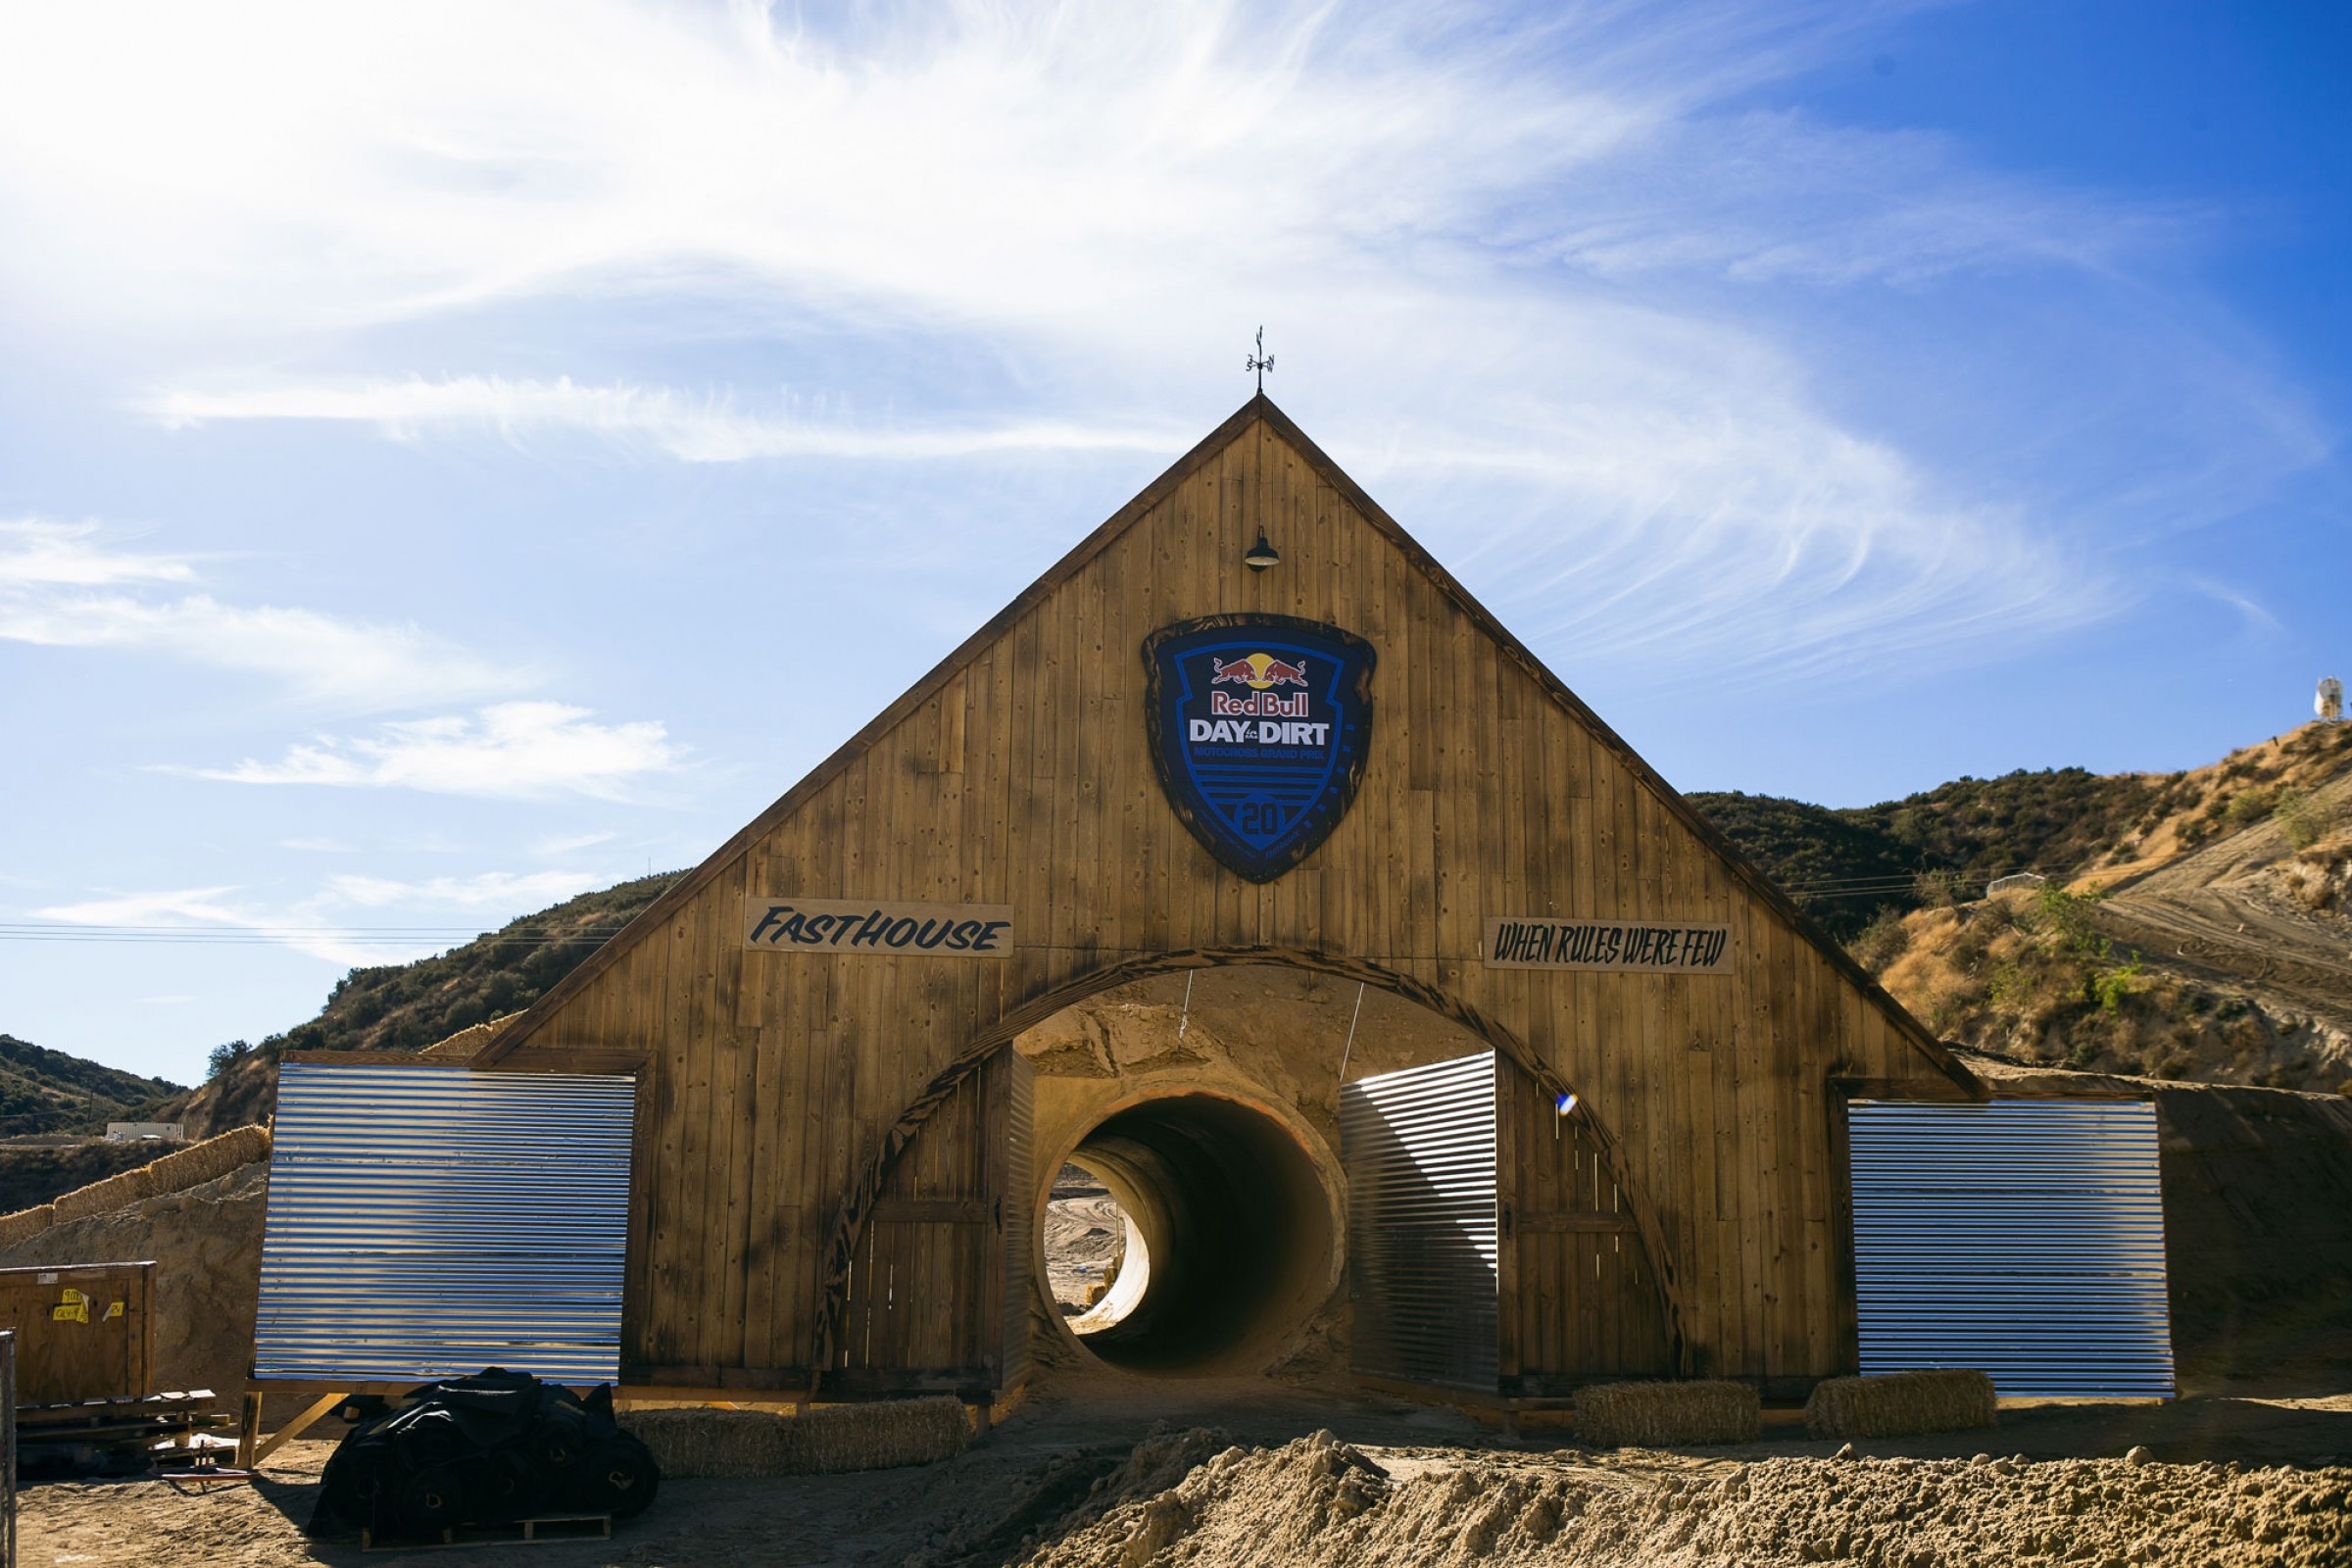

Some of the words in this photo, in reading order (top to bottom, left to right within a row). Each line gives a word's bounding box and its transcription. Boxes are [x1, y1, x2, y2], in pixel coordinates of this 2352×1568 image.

[1211, 691, 1260, 716] Red
[1261, 692, 1309, 717] Bull
[1190, 718, 1251, 743] DAY
[1258, 721, 1330, 746] DIRT
[1194, 746, 1258, 759] MOTOCROSS
[1241, 802, 1279, 834] 20
[750, 906, 1011, 952] FASTHOUSE
[1494, 922, 1555, 963] WHEN
[1554, 925, 1621, 964] RULES
[1622, 927, 1683, 966] WERE
[1680, 929, 1728, 967] FEW
